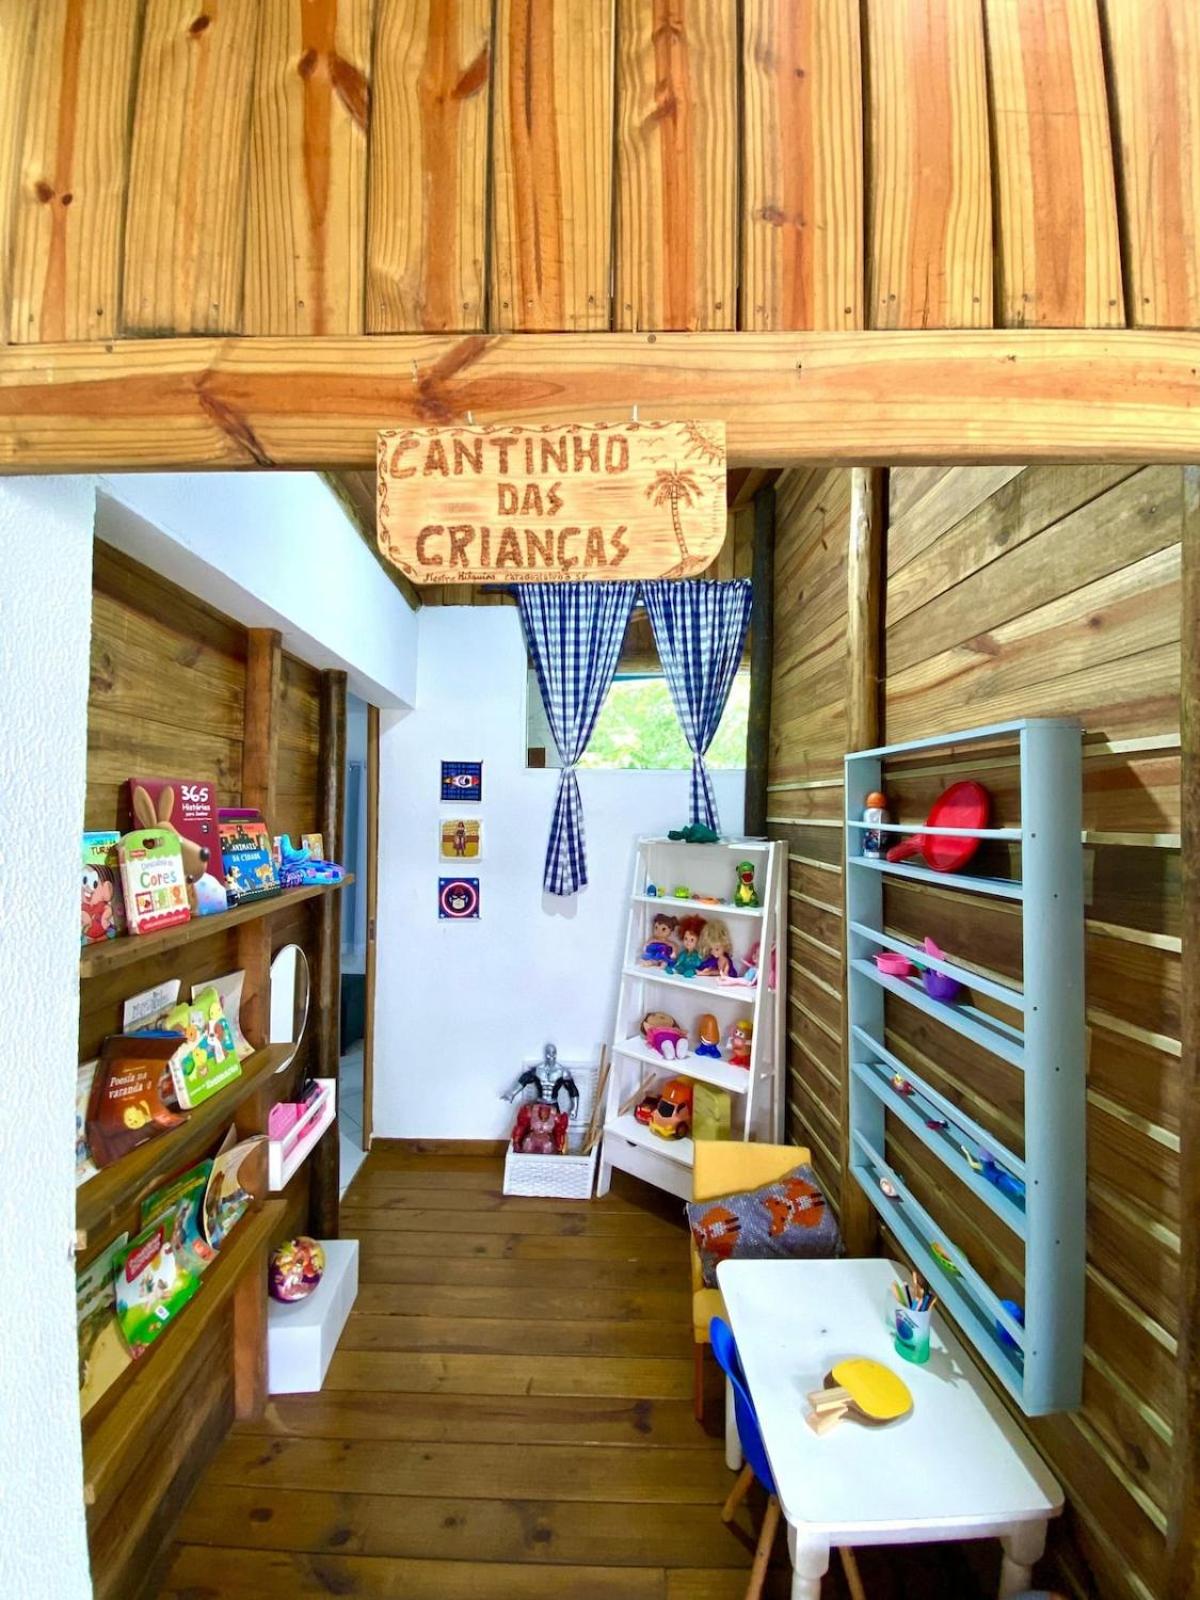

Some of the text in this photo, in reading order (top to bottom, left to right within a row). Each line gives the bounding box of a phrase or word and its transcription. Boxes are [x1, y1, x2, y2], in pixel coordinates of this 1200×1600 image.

[390, 432, 630, 480] CANTINHO
[497, 481, 564, 517] DAS
[415, 524, 630, 572] CRIANÇAS
[180, 785, 209, 803] 365
[140, 870, 178, 889] Cores
